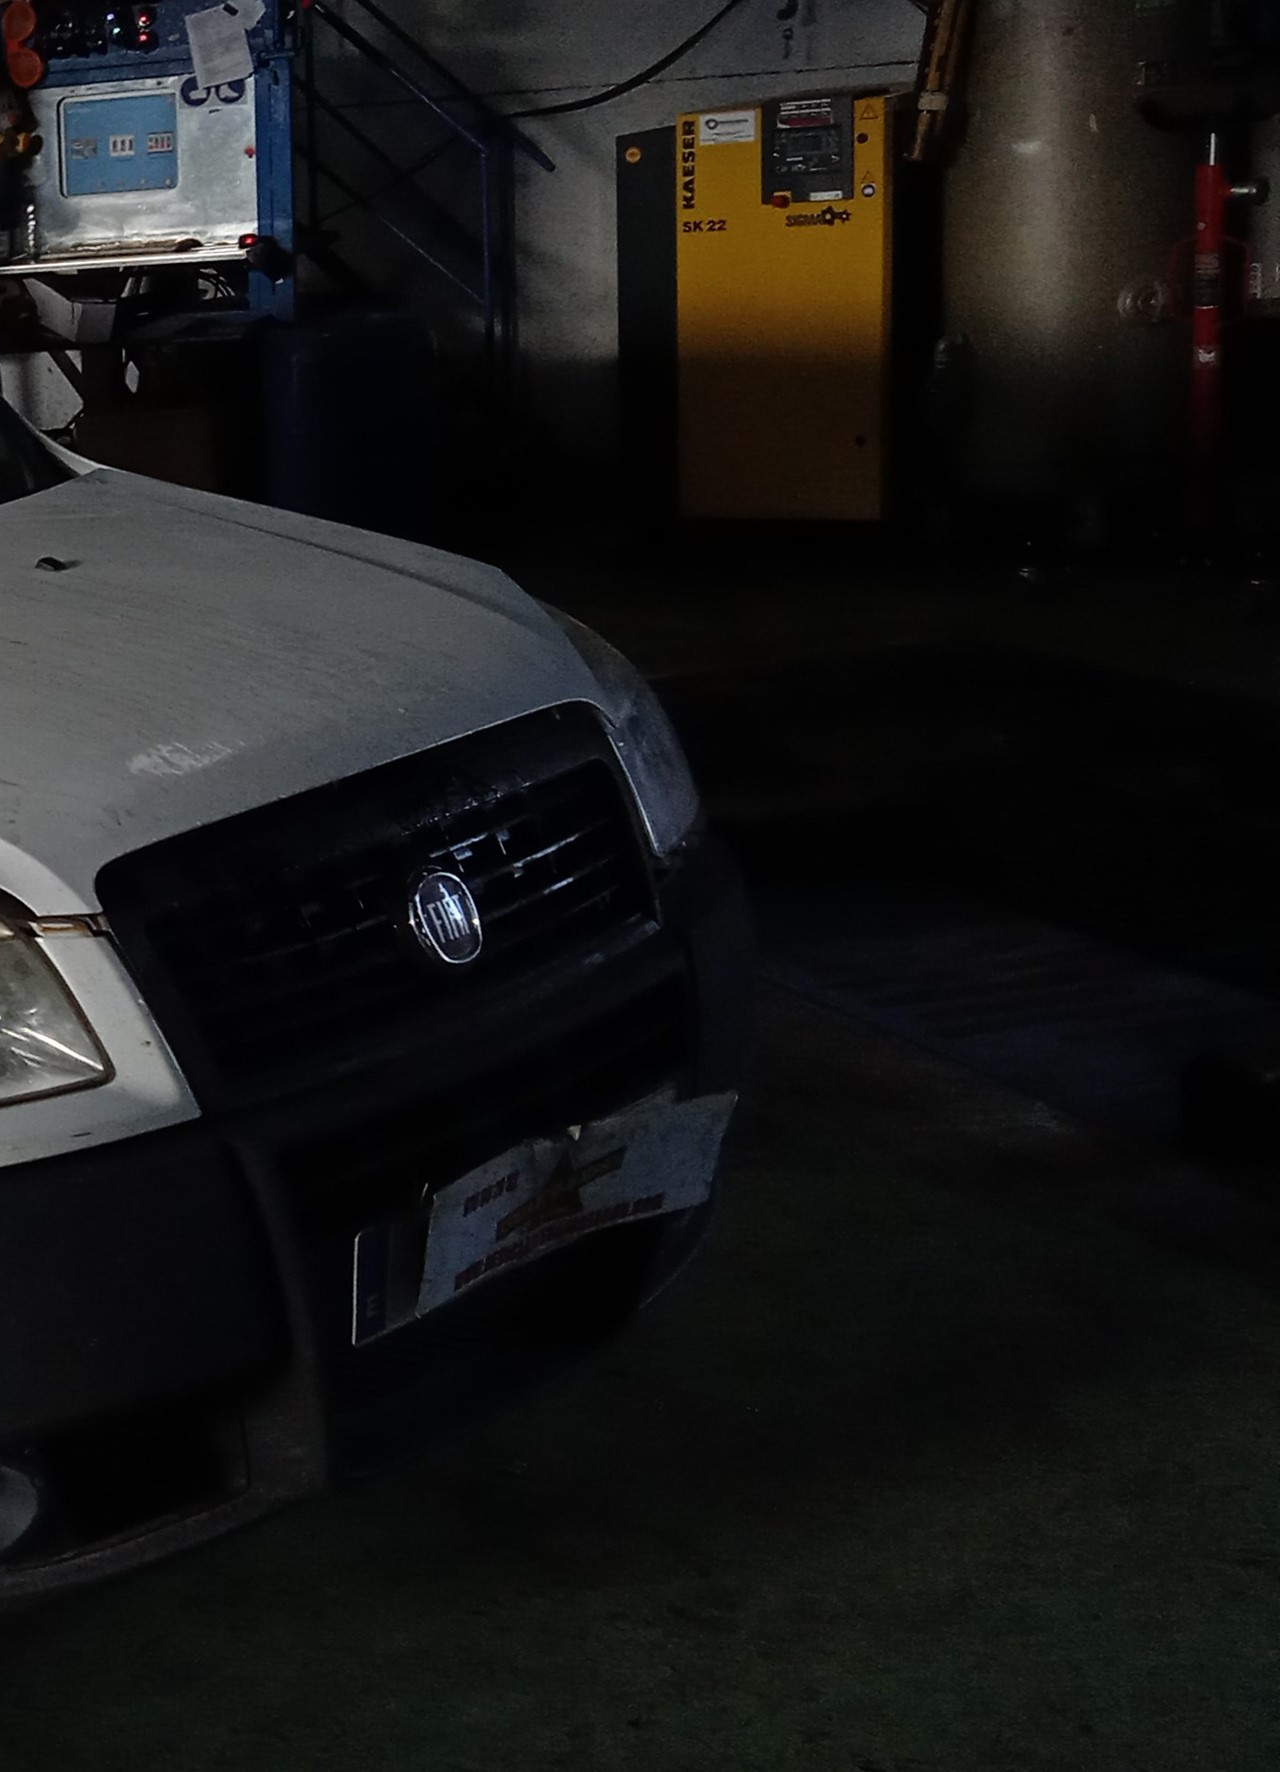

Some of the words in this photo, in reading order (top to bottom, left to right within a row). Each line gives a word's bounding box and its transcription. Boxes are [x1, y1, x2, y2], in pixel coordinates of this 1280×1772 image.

[682, 120, 695, 209] KAESER
[682, 221, 703, 233] SK
[706, 219, 727, 232] 22
